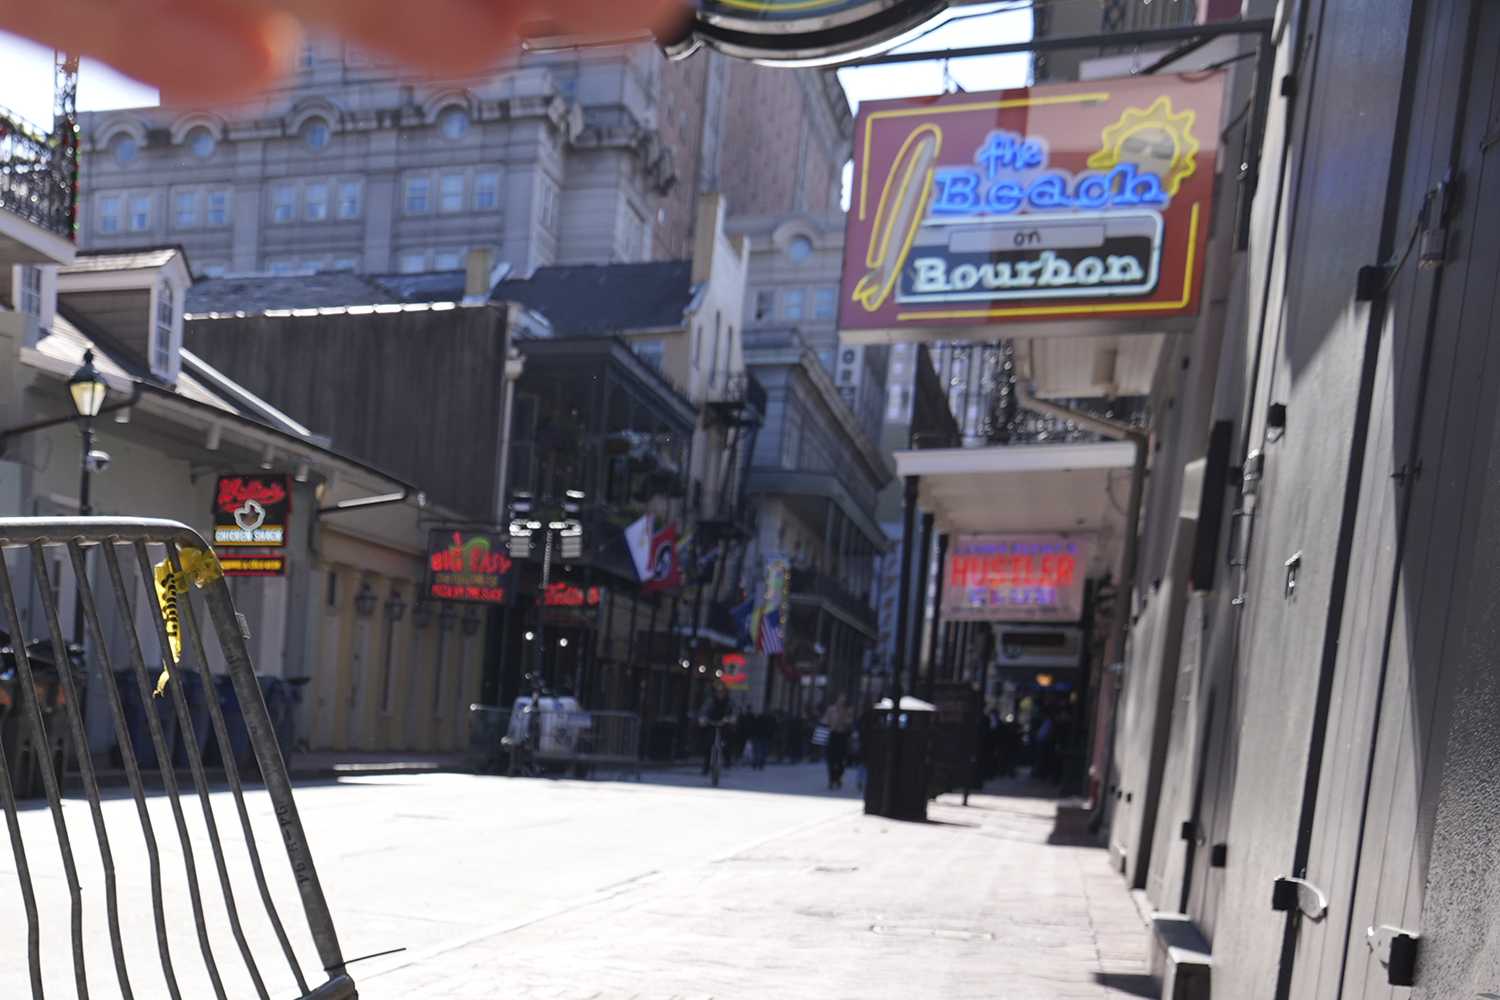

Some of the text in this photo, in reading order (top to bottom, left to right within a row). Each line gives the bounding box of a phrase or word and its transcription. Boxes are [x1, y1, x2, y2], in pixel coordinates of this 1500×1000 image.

[981, 134, 1043, 178] the
[932, 163, 1169, 213] Beach
[1014, 227, 1042, 247] on
[913, 251, 1144, 293] Bourbon
[431, 548, 513, 575] BIG EASY
[951, 555, 1076, 587] HUSTLER
